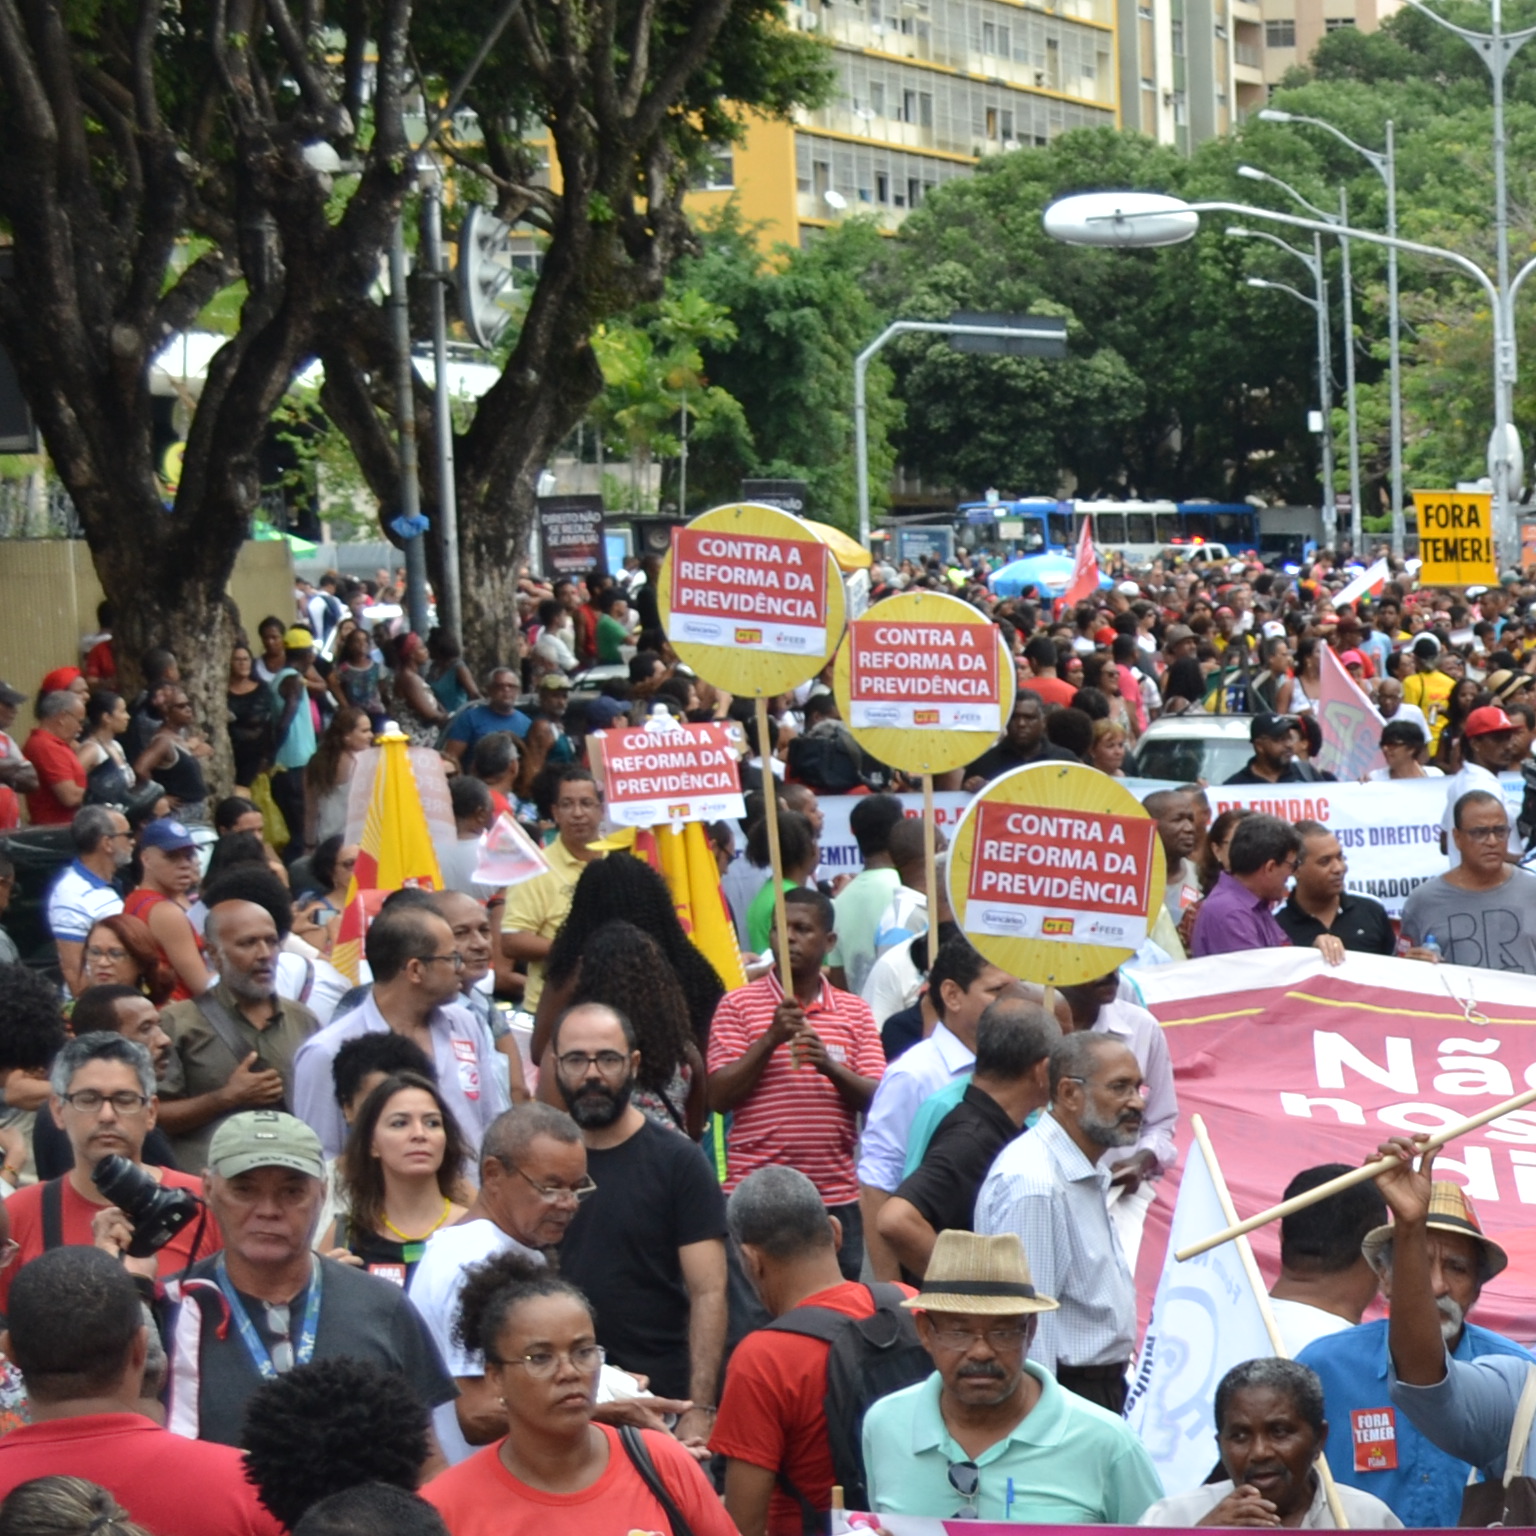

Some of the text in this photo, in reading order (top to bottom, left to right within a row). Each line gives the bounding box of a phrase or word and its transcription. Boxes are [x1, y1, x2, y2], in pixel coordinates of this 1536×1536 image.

[1424, 502, 1481, 530] FORA
[698, 538, 802, 565] CONTRA A
[1420, 536, 1491, 564] TEMER!
[681, 562, 814, 592] REFORMA DA
[681, 587, 817, 619] PREVIDÊNCIA
[874, 627, 974, 646] CONTRA A
[859, 652, 987, 671] REFORMA DA
[861, 674, 990, 696] PREVIDÊNCIA
[623, 729, 712, 749] CONTRA A
[611, 750, 726, 773] REFORMA DA
[616, 772, 732, 795] PREVIDÊNCIA
[1250, 797, 1330, 822] FUNDAC
[1007, 813, 1125, 844] CONTRA A
[1369, 824, 1442, 846] DIREITOS
[983, 840, 1137, 875] REFORMA DA
[981, 871, 1138, 906] PREVIDÊNCIA
[1358, 1413, 1390, 1428] FORA
[1355, 1427, 1395, 1443] TEMER
